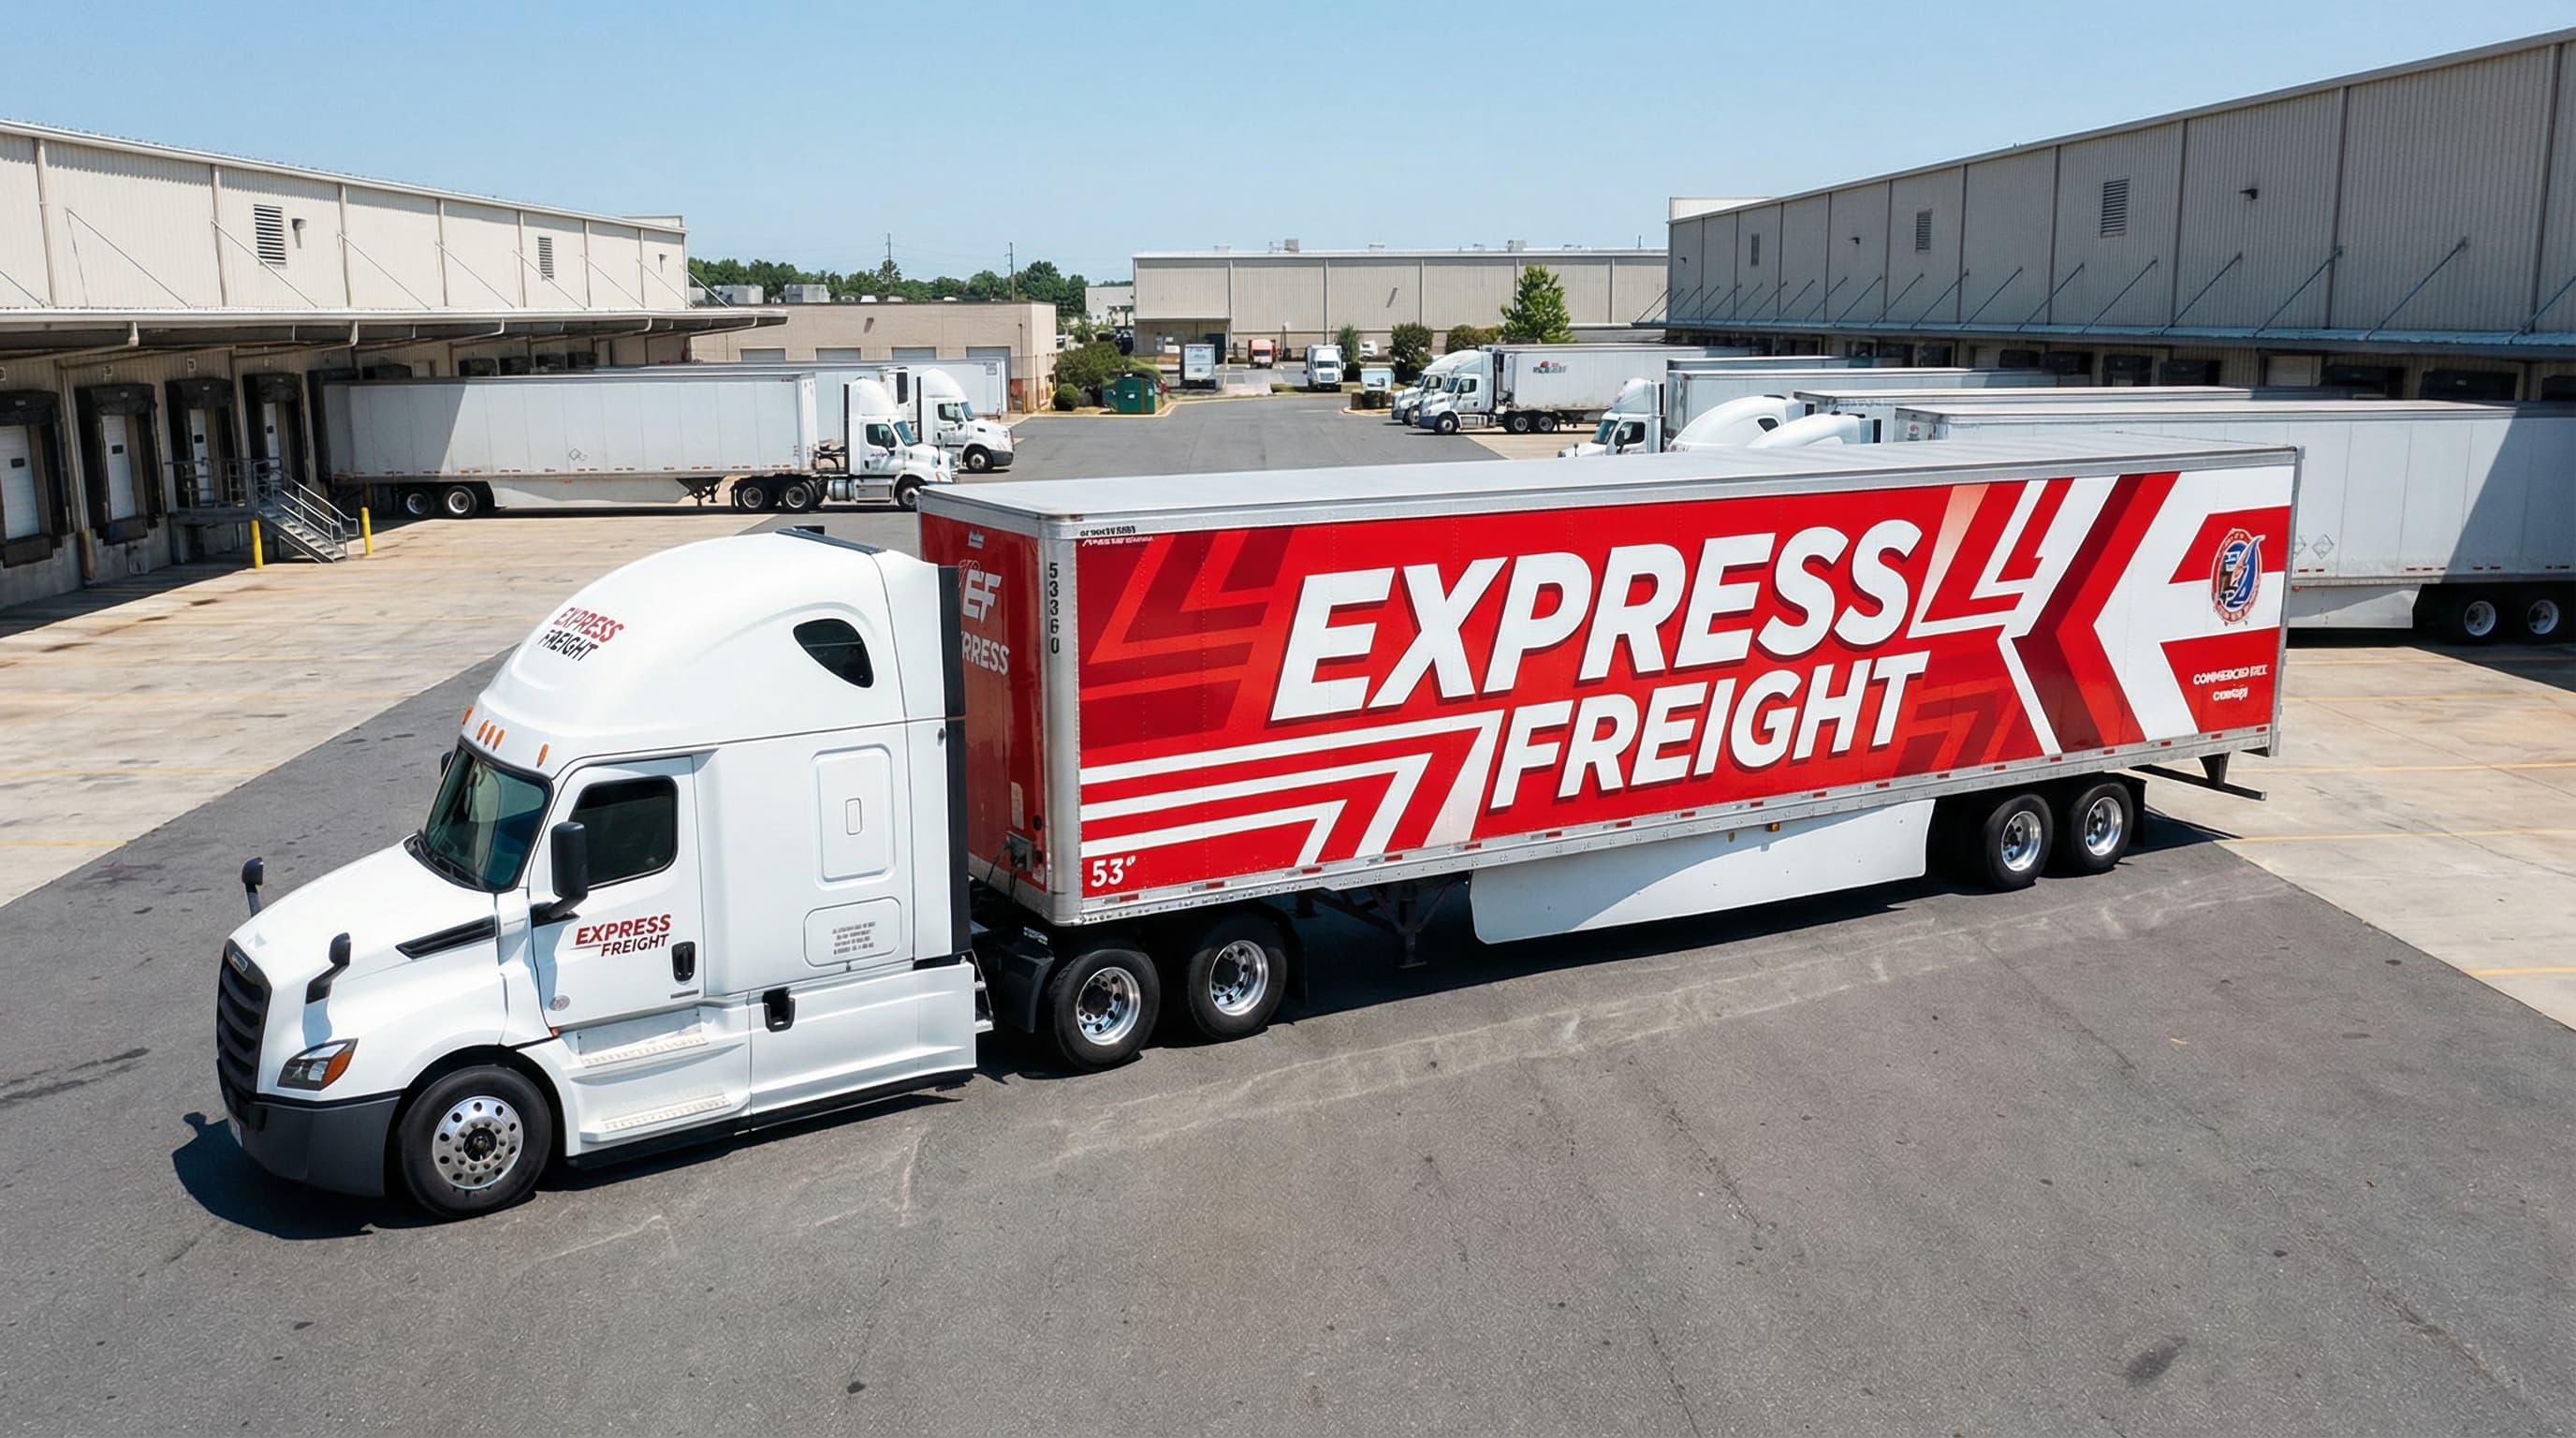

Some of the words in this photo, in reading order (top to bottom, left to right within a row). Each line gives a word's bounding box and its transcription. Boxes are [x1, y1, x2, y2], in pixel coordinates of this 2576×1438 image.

[962, 568, 1003, 624] EF
[1048, 562, 1060, 654] 53360
[553, 607, 624, 642] EXPRESS
[1269, 519, 1924, 723] EXPRESS
[538, 629, 598, 661] FREIGHT
[960, 630, 1010, 675] RRESS
[1490, 651, 1931, 811] FREIGHT
[575, 914, 672, 946] EXPRESS
[600, 933, 670, 957] FREIGHT
